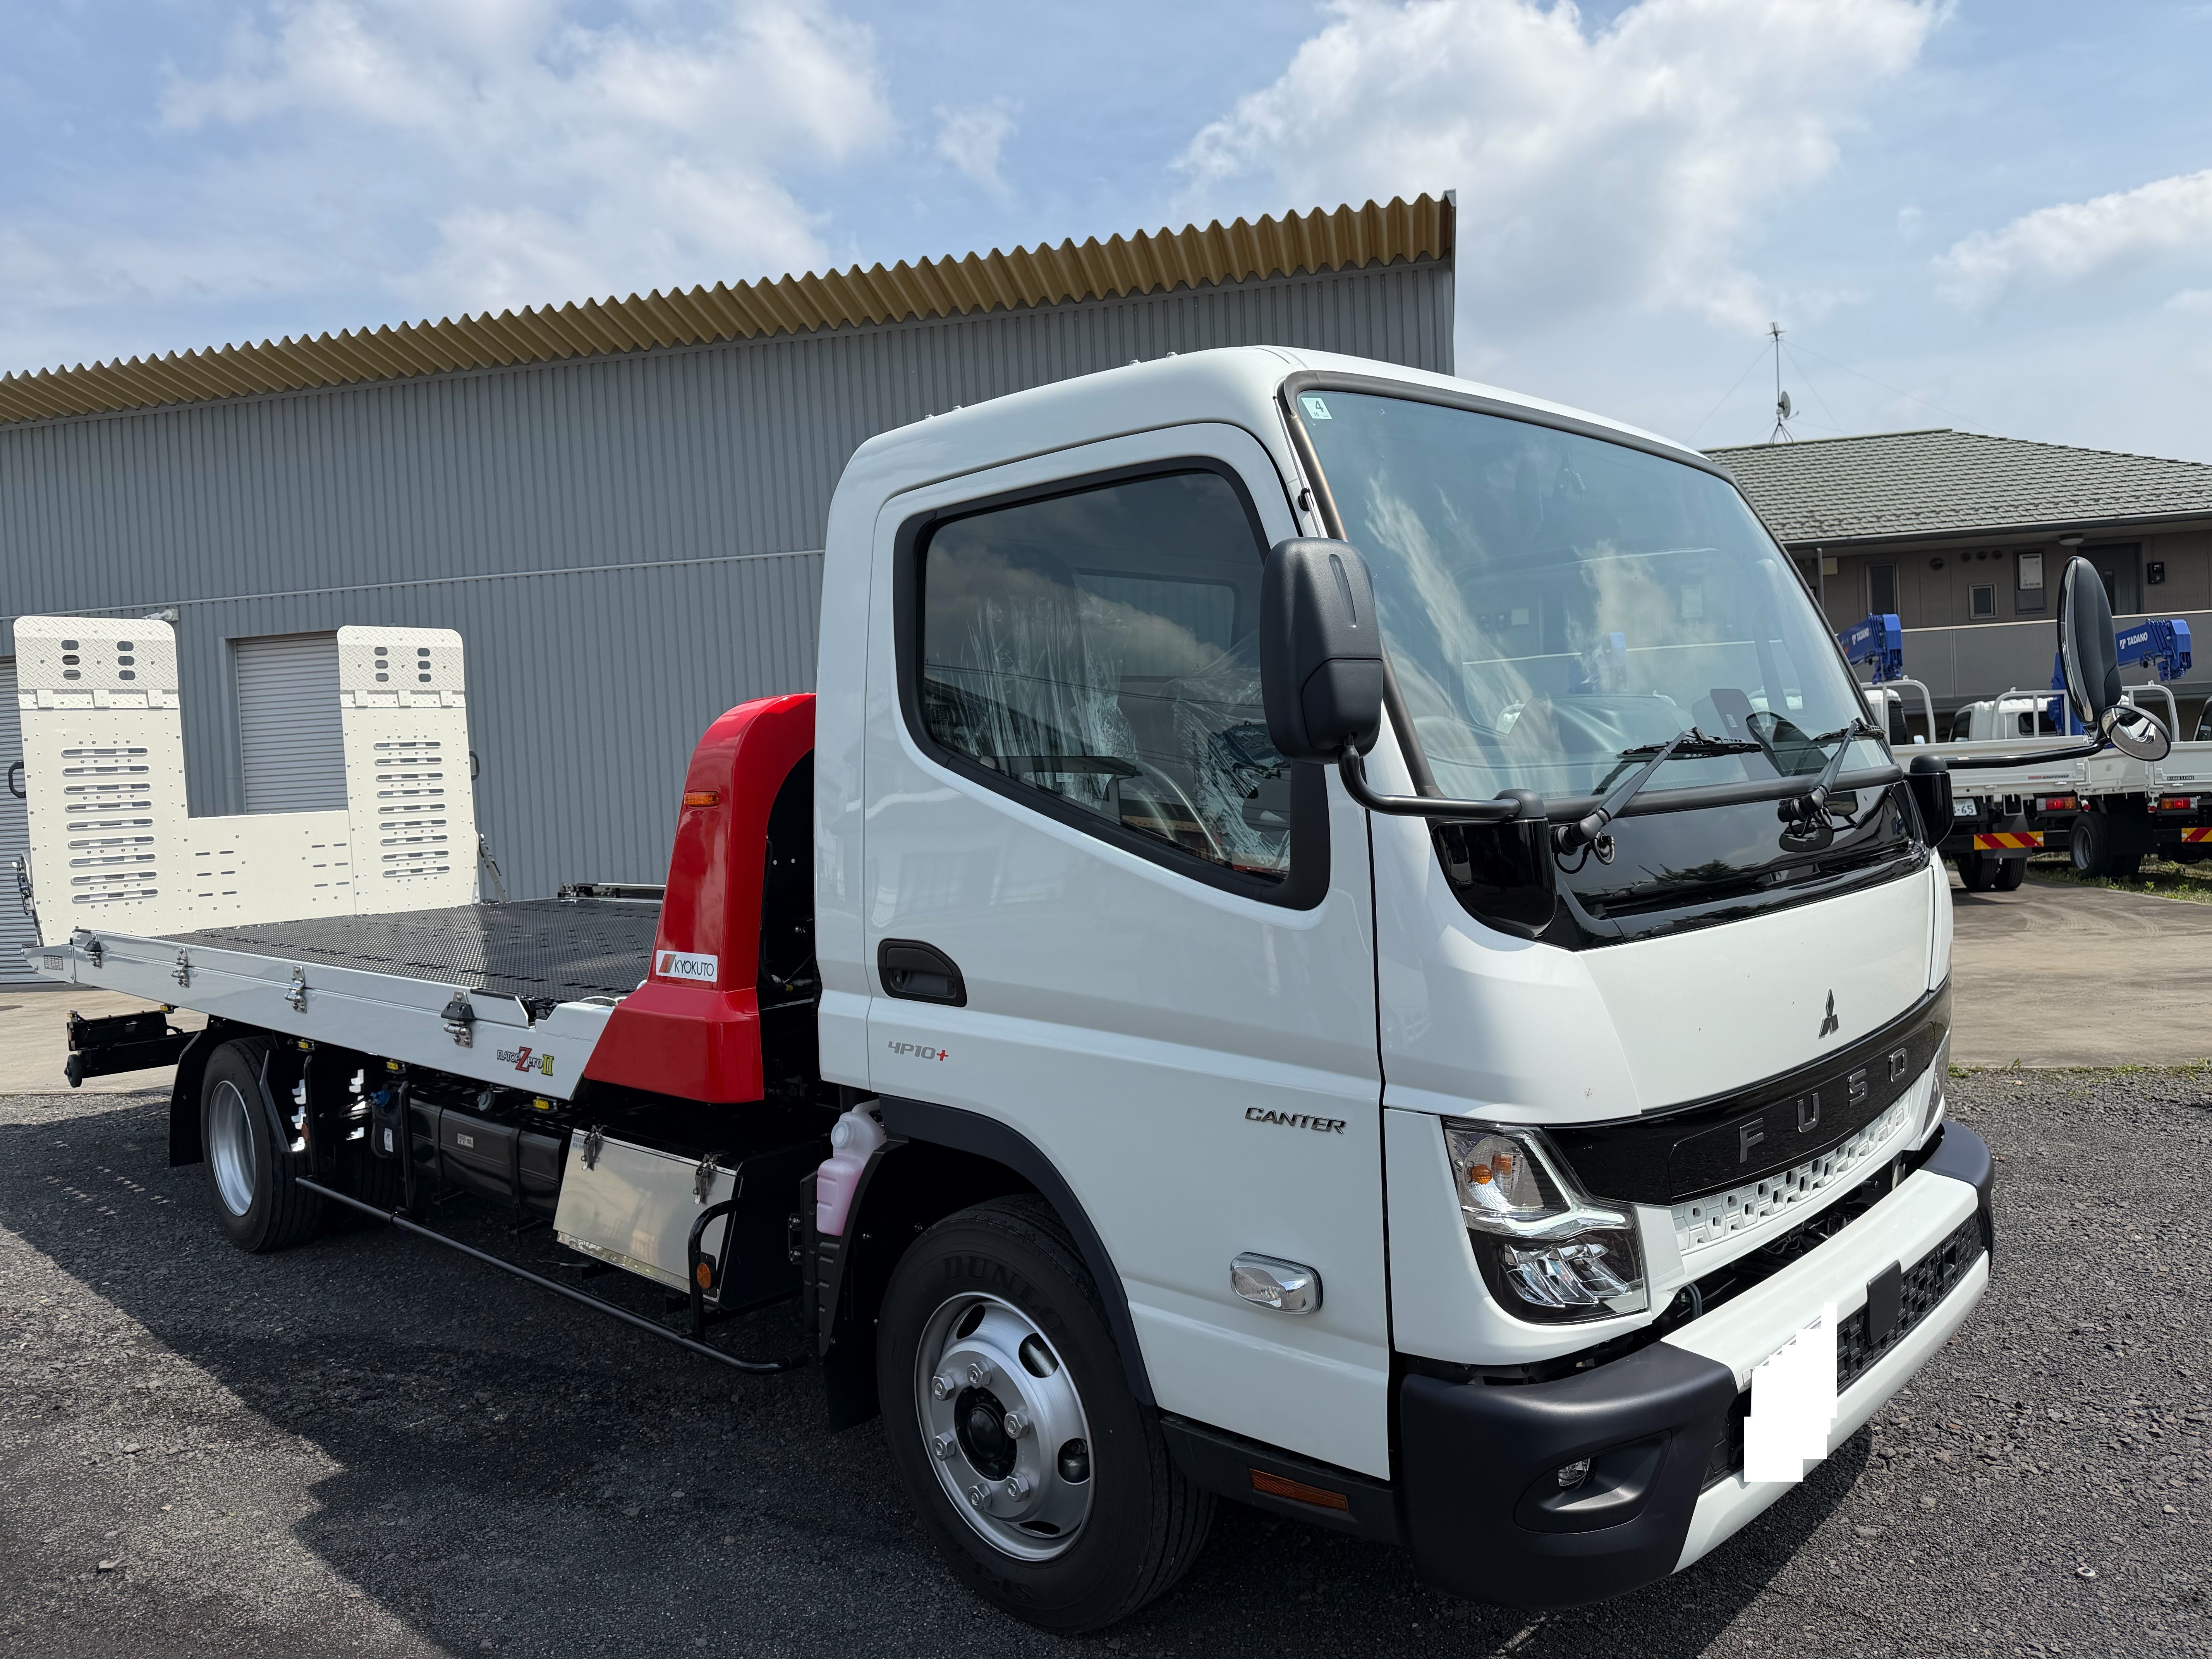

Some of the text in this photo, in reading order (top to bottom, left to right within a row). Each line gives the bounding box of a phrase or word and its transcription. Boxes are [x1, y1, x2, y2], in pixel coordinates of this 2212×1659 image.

[1315, 400, 1324, 412] 4
[2127, 632, 2148, 646] TADANO
[675, 959, 714, 976] KYOKUTO
[1739, 1048, 1908, 1163] FUSO
[1245, 1106, 1346, 1134] CANTER
